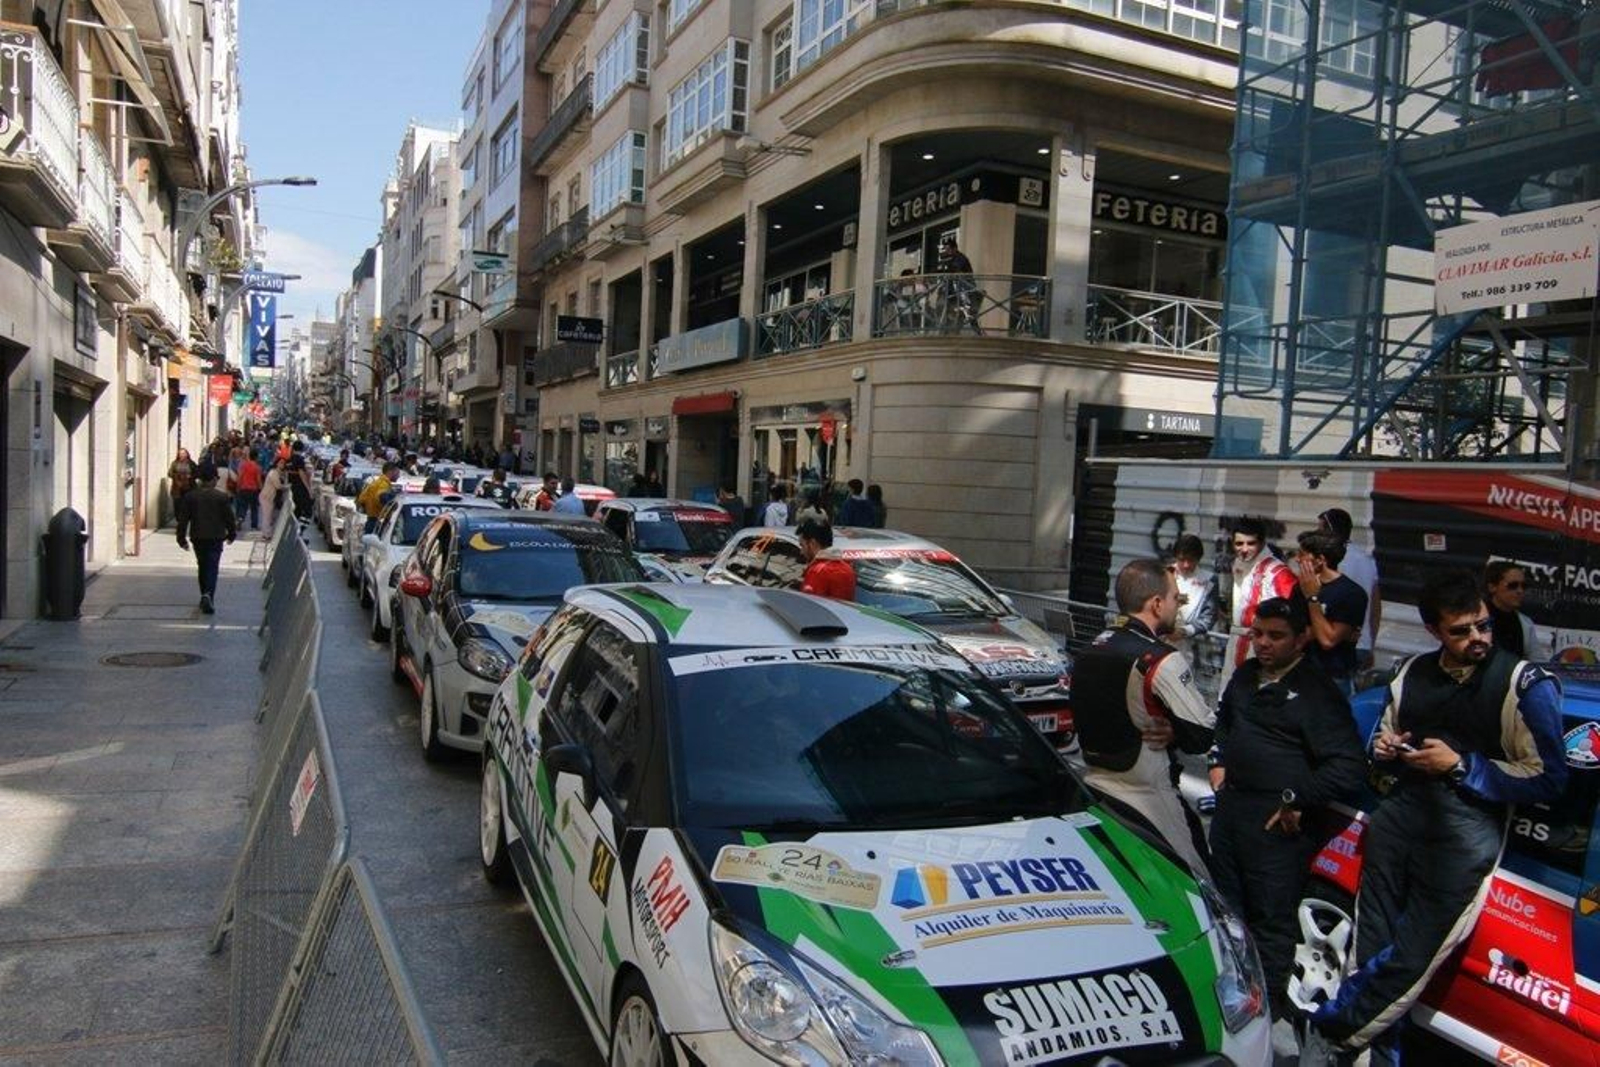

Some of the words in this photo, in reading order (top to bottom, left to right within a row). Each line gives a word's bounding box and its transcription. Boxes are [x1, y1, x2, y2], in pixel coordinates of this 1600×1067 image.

[1501, 222, 1545, 237] ESTRUCTURA
[1438, 256, 1510, 282] CLAVIMAR
[1486, 284, 1506, 297] 986
[1510, 281, 1532, 294] 339
[1535, 278, 1558, 290] 709
[256, 296, 270, 366] VIVAS
[1161, 415, 1200, 432] TARTANA
[1487, 484, 1567, 522] NUEVA
[792, 648, 949, 667] CARMOTIVE
[592, 843, 611, 900] 24
[781, 849, 822, 871] 24
[646, 855, 691, 934] PMH
[827, 877, 875, 892] BAIXAS
[951, 856, 1102, 900] PEYSER
[1487, 885, 1537, 919] Nube
[633, 875, 671, 970] MOTORSPORT
[913, 914, 991, 940] Alquiler
[997, 907, 1018, 923] de
[983, 970, 1171, 1038] SUMACO
[1141, 1019, 1180, 1038] S.A.
